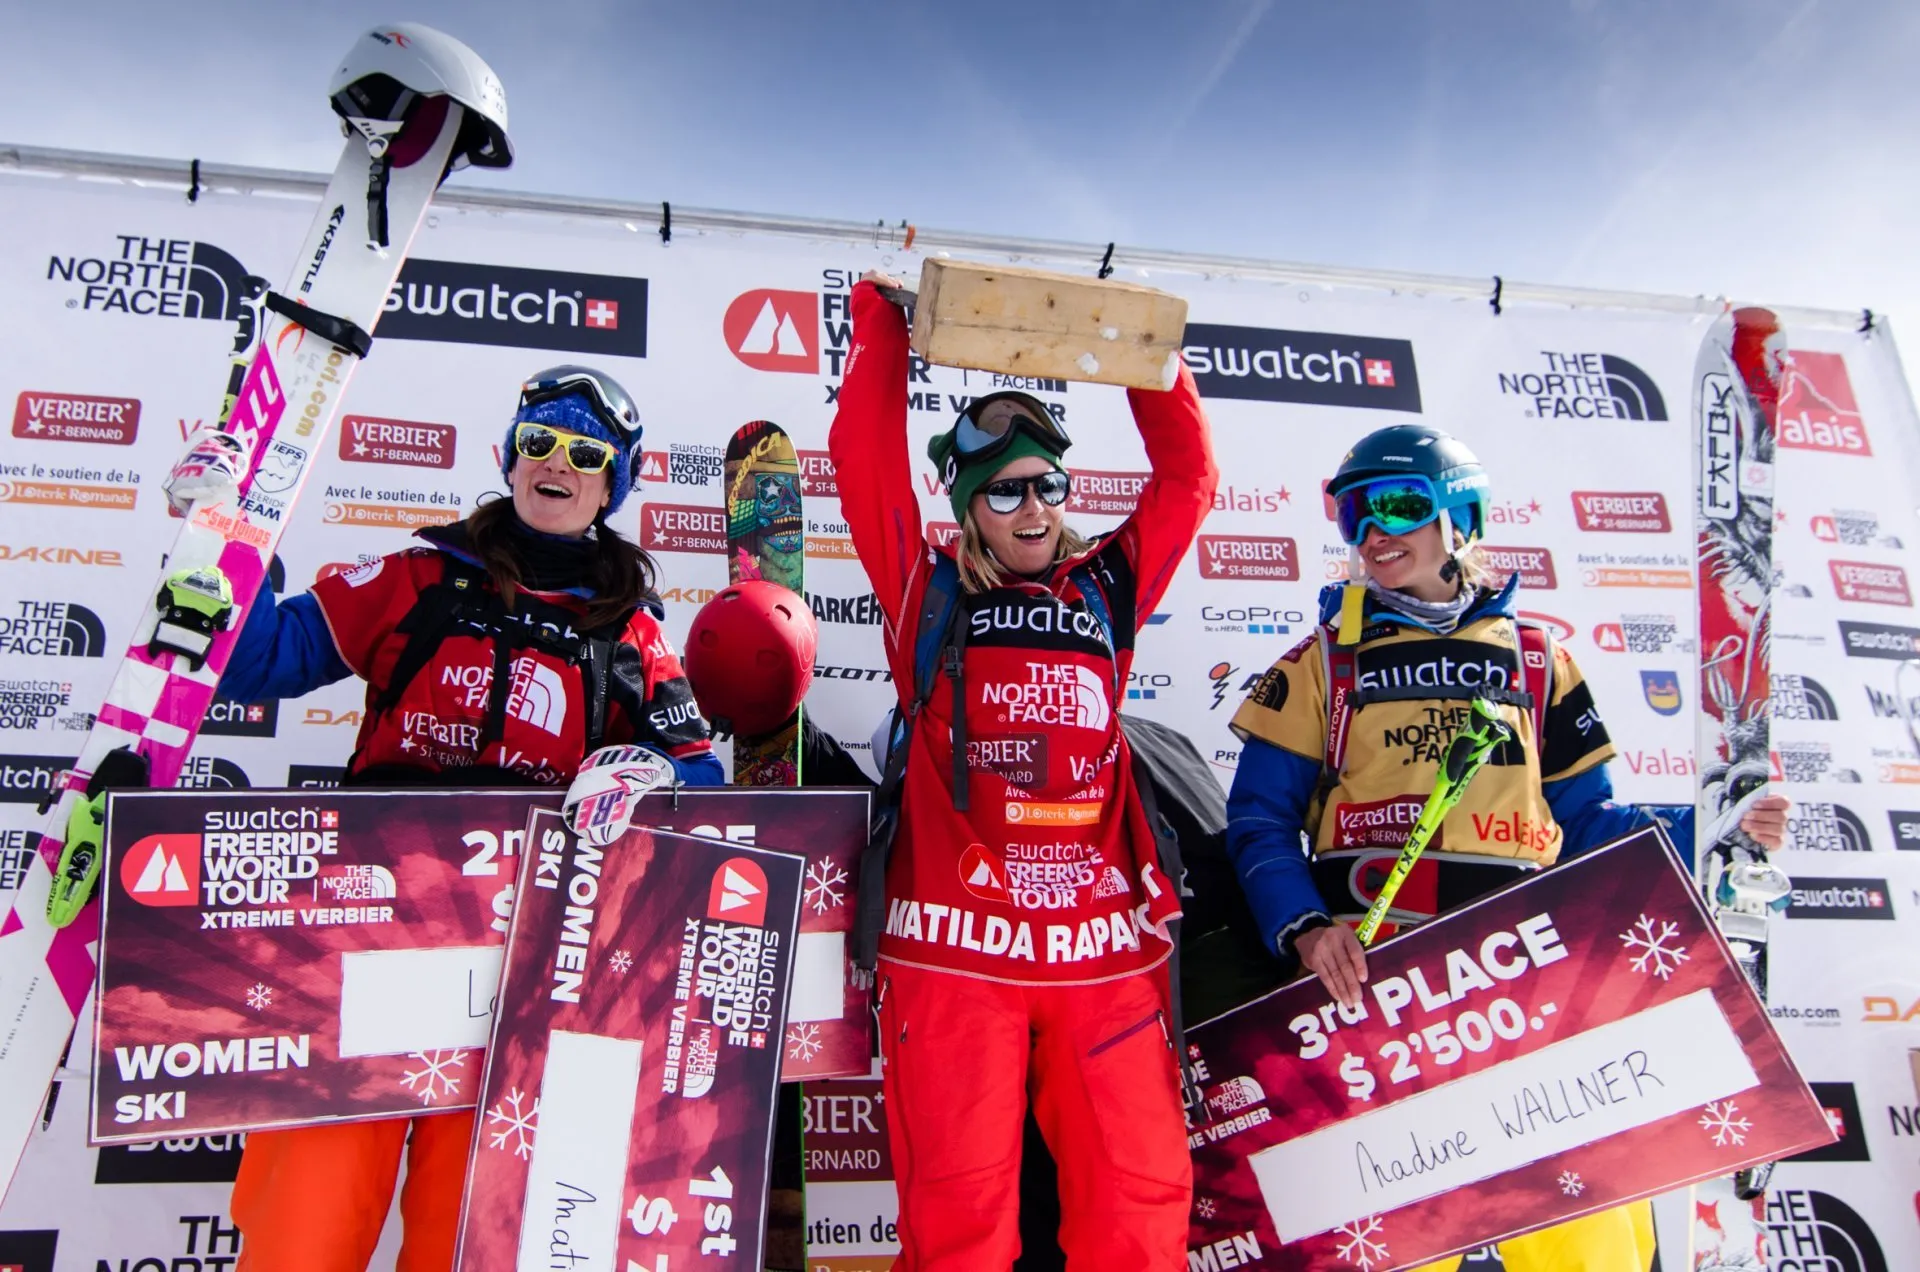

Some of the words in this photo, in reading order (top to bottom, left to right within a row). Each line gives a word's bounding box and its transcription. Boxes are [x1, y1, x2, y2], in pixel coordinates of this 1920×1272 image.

[116, 235, 190, 265] THE
[47, 256, 187, 291] NORTH
[83, 285, 183, 318] FACE
[383, 282, 580, 326] swatch
[1183, 346, 1362, 385] swatch
[1540, 351, 1600, 374] THE
[1499, 373, 1606, 396] NORTH
[27, 398, 125, 424] VERBIER
[1535, 397, 1614, 418] FACE
[47, 424, 124, 441] ST-BERNARD
[352, 423, 442, 448] VERBIER
[1783, 411, 1862, 449] alais
[372, 447, 442, 465] ST-BERNARD
[670, 443, 720, 456] swatch
[670, 453, 723, 468] FREERID
[32, 464, 45, 477] le
[50, 467, 101, 481] soutien
[106, 469, 124, 482] de
[128, 470, 140, 483] la
[670, 464, 721, 477] WORLD
[670, 474, 708, 486] TOUR
[16, 485, 66, 500] Loterie
[69, 488, 134, 504] Romande
[325, 485, 356, 500] Avec
[360, 486, 372, 501] le
[377, 487, 425, 503] soutien
[429, 490, 445, 505] de
[449, 491, 461, 506] la
[1070, 476, 1143, 496] VERBIER
[236, 496, 281, 521] TEAM
[1088, 500, 1137, 511] ST-BERNA
[1213, 487, 1278, 512] alais
[1578, 496, 1659, 515] VERBIER
[349, 509, 392, 523] Loterie
[650, 510, 726, 533] VERBIE
[1491, 503, 1531, 524] ais
[1603, 518, 1661, 530] ST-BERNARD
[808, 519, 819, 532] le
[823, 521, 850, 534] sout
[672, 537, 728, 550] ST-BERNAR
[805, 542, 840, 554] oterie
[1205, 540, 1287, 561] VERBIER
[1323, 544, 1347, 555] Avec
[1578, 553, 1601, 565] Avec
[1618, 555, 1657, 566] soutien
[1228, 565, 1289, 577] ST-BERNARD
[18, 601, 65, 619] THE
[809, 593, 883, 625] ARKER
[1202, 606, 1303, 623] GoPro
[0, 618, 62, 637] ORTH
[1026, 662, 1076, 684] THE
[1128, 672, 1172, 686] Pro
[982, 683, 1077, 705] NORTH
[1771, 690, 1803, 703] RTH
[1009, 703, 1076, 725] FACE
[1328, 686, 1346, 753] ORTOVOX
[1774, 704, 1809, 719] ACE
[0, 717, 37, 730] OUR
[403, 711, 478, 751] VERBIER
[1384, 724, 1457, 748] NORT
[966, 740, 1033, 762] BIER
[1412, 746, 1443, 766] FA
[1625, 749, 1695, 775] Valai
[182, 757, 210, 773] HE
[204, 807, 319, 830] swatch
[1340, 803, 1422, 829] VERBIER
[1798, 803, 1834, 819] THE
[1787, 818, 1836, 835] ORTH
[203, 832, 338, 855] FREERIDE
[1006, 843, 1083, 861] swatch
[1397, 823, 1427, 875] LEKI
[1796, 835, 1842, 850] FACE
[202, 856, 320, 880] WORLD
[534, 828, 565, 890] SKI
[345, 865, 371, 877] THE
[202, 880, 289, 905] TOUR
[323, 876, 371, 889] NORTH
[336, 888, 371, 900] FACE
[1009, 888, 1078, 909] TOUR
[1792, 886, 1870, 907] swatch
[200, 910, 294, 930] XTREME
[301, 906, 393, 926] VERBIER
[550, 838, 605, 1004] WOMEN
[886, 898, 1036, 962] MATILDA
[675, 917, 701, 1001] XTREME
[694, 923, 724, 998] TOUR
[1372, 913, 1568, 1027] PLACE
[712, 926, 743, 1028] WORLD
[728, 926, 763, 1047] FREERIDE
[752, 930, 779, 1030] swatch
[1768, 1005, 1841, 1019] ato.com
[115, 1035, 310, 1081] WOMEN
[661, 1005, 688, 1095] VERBIER
[686, 1037, 700, 1075] FACE
[694, 1027, 711, 1077] NORTH
[703, 1048, 718, 1077] THE
[1220, 1078, 1239, 1093] THE
[1339, 1053, 1376, 1101] $
[1210, 1089, 1244, 1108] NORTH
[1222, 1097, 1248, 1114] FACE
[1491, 1050, 1664, 1140] WALLNER
[114, 1091, 186, 1124] SKI
[803, 1096, 880, 1133] BIER
[1205, 1107, 1272, 1143] VERBIER
[804, 1150, 881, 1170] ERNARD
[627, 1194, 678, 1236] $
[689, 1165, 737, 1257] 1st
[179, 1216, 240, 1254] TH
[806, 1217, 861, 1244] utien
[870, 1215, 897, 1243] de
[1187, 1231, 1263, 1272] MEN
